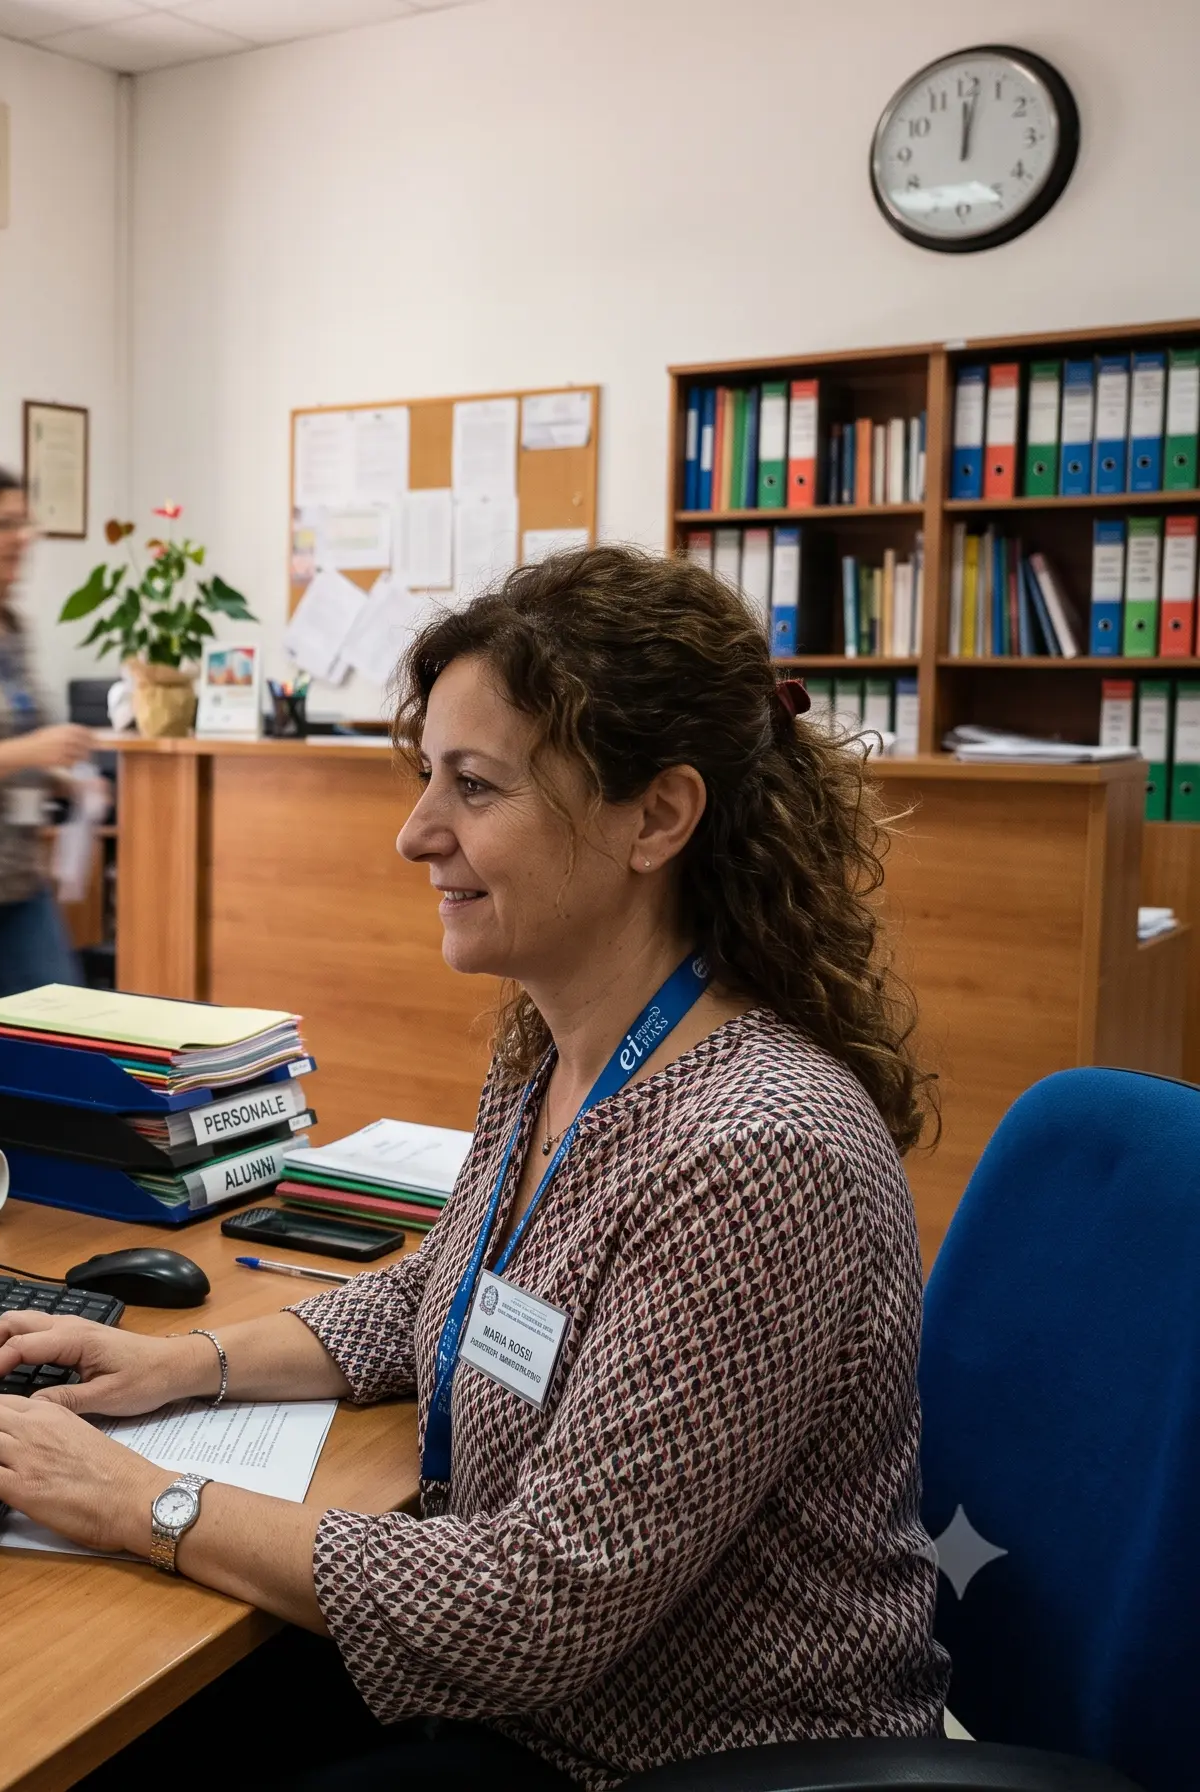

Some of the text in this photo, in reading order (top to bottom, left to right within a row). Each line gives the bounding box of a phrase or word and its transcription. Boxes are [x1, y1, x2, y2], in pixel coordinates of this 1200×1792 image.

[957, 76, 980, 98] 12
[995, 79, 1002, 100] 1
[929, 89, 947, 113] 11
[1011, 96, 1027, 118] 2
[908, 117, 931, 139] 10
[1023, 127, 1037, 148] 3
[203, 1094, 286, 1135] PERSONALE
[225, 1155, 276, 1191] ALUNNI
[482, 1325, 507, 1348] MARIA
[507, 1339, 533, 1362] ROSSI
